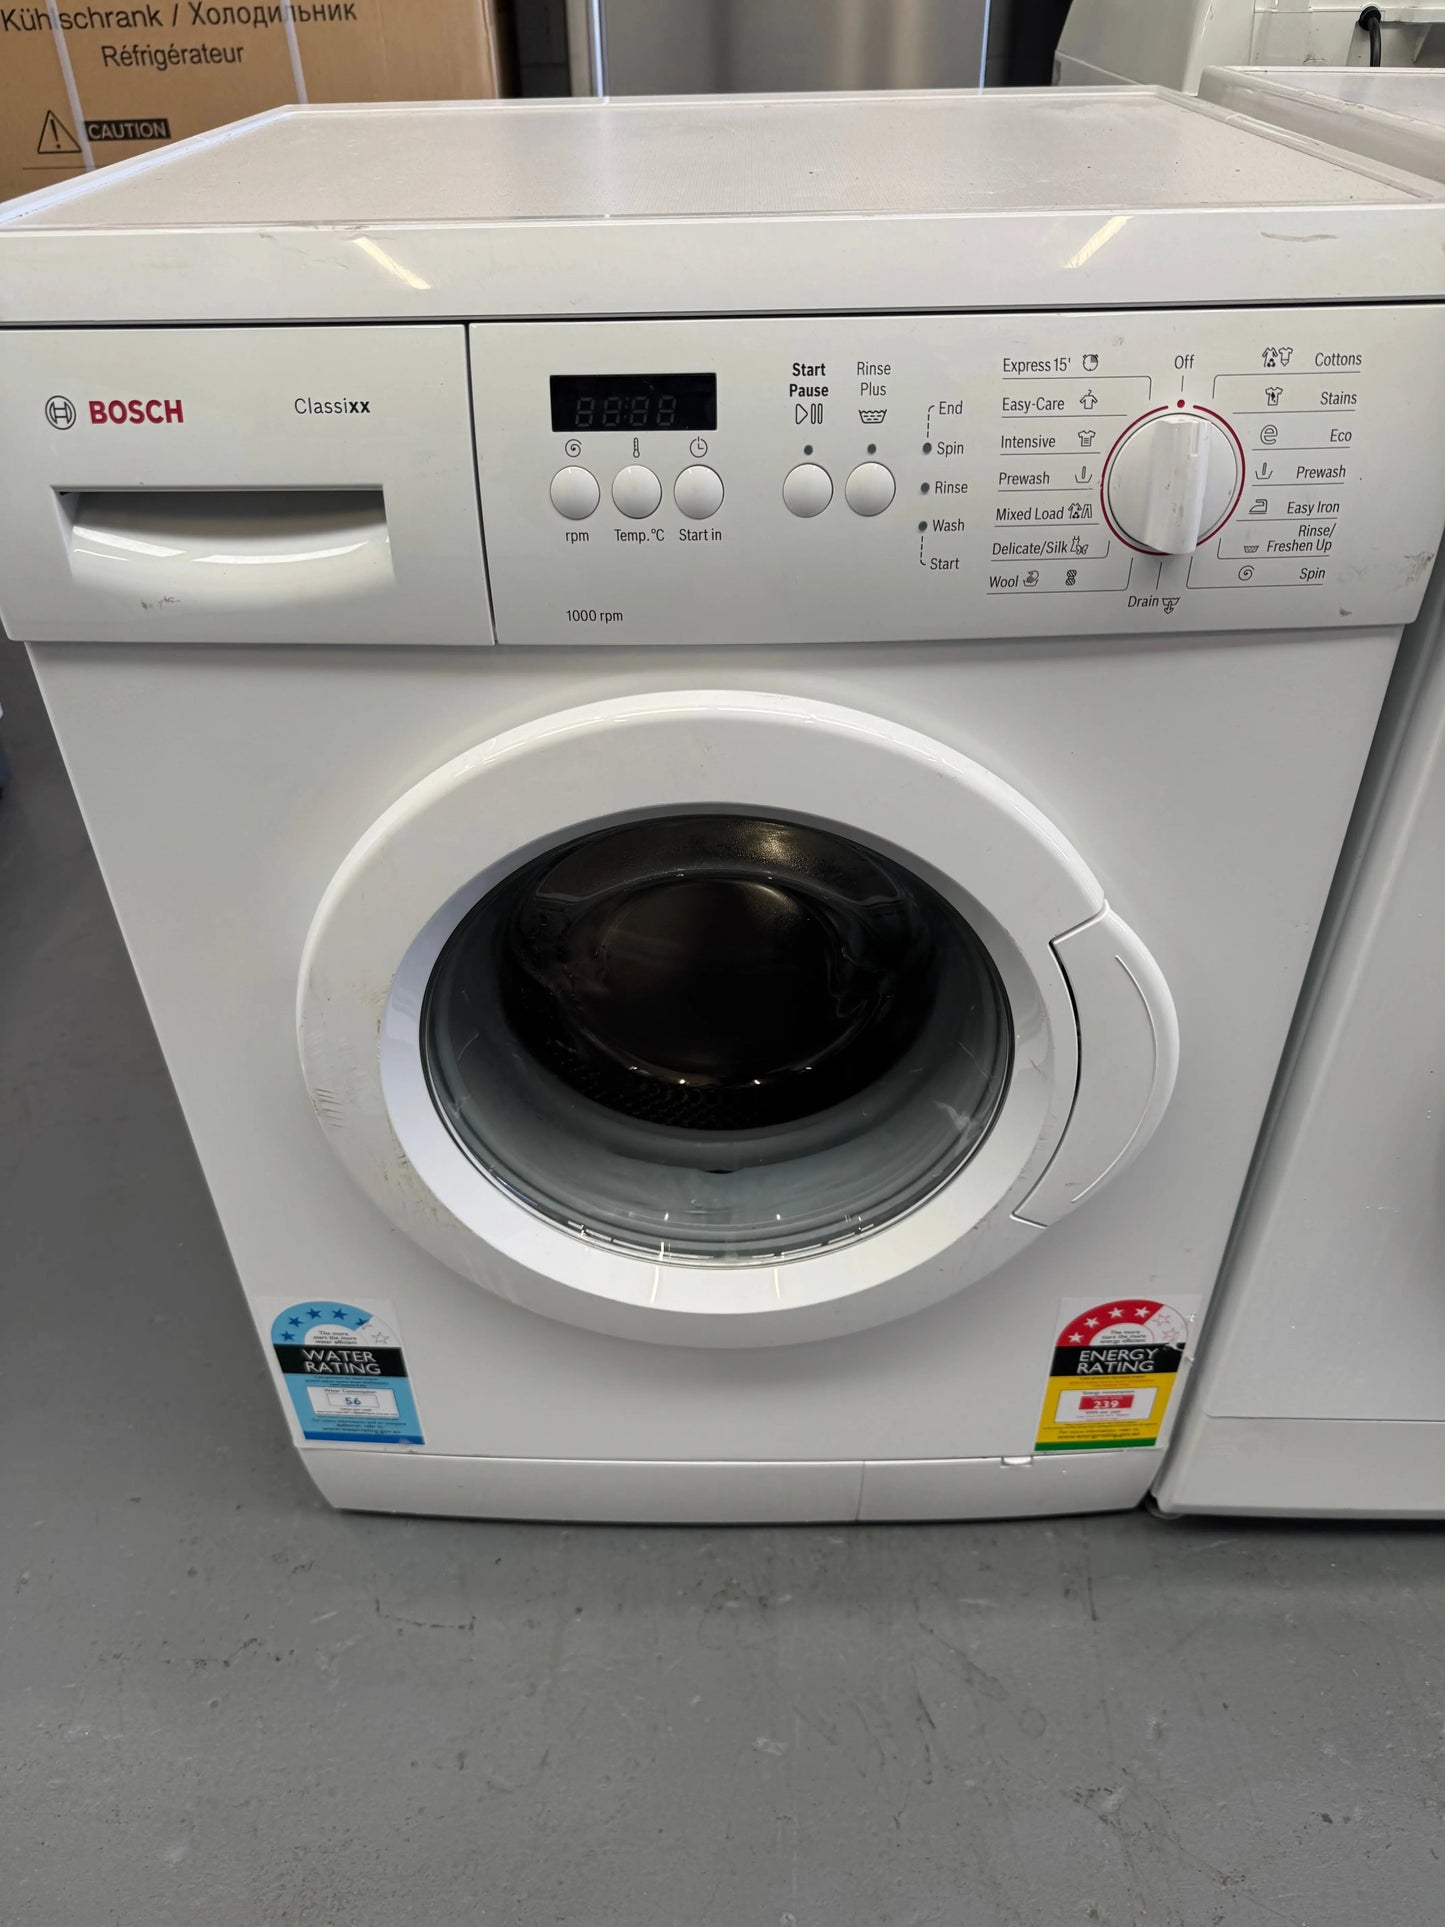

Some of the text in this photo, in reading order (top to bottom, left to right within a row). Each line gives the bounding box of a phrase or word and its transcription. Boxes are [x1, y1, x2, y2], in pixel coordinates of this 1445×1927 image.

[172, 3, 178, 27] /
[101, 43, 244, 71] Réfrigérateur
[87, 122, 167, 140] CAUTION
[1175, 355, 1194, 369] Off
[1315, 353, 1362, 366] Cottons
[793, 363, 825, 376] Start
[857, 362, 891, 375] Rinse
[1004, 358, 1051, 375] Express
[790, 384, 828, 397] Pause
[861, 382, 886, 396] Plus
[1320, 391, 1357, 405] Stains
[88, 400, 184, 424] BOSCH
[294, 397, 371, 415] Classixx
[939, 400, 963, 414] End
[1003, 397, 1064, 414] Easy-Care
[1001, 435, 1055, 448] Intensive
[1330, 429, 1352, 442] Eco
[937, 441, 963, 457] Spin
[999, 471, 1049, 485] Prewash
[1297, 465, 1345, 478] Prewash
[935, 481, 968, 494] Rinse
[996, 507, 1064, 520] Mixed Load
[1287, 501, 1339, 516] Easy Iron
[933, 518, 964, 531] Wash
[566, 532, 589, 544] rpm
[680, 528, 721, 541] Start in
[1299, 523, 1336, 540] Rinse/
[993, 541, 1067, 556] Delicate/Silk
[1267, 539, 1332, 554] Freshen Up
[930, 558, 959, 570] Start
[990, 575, 1018, 587] Wool
[1300, 568, 1325, 581] Spin
[1128, 595, 1159, 607] Drain
[567, 610, 623, 623] 1000 rpm
[303, 1350, 377, 1362] WATER
[1080, 1348, 1158, 1362] ENERGY
[305, 1362, 381, 1375] RATING
[1077, 1361, 1155, 1374] RATING
[344, 1397, 361, 1405] 56
[1093, 1400, 1119, 1409] 239
